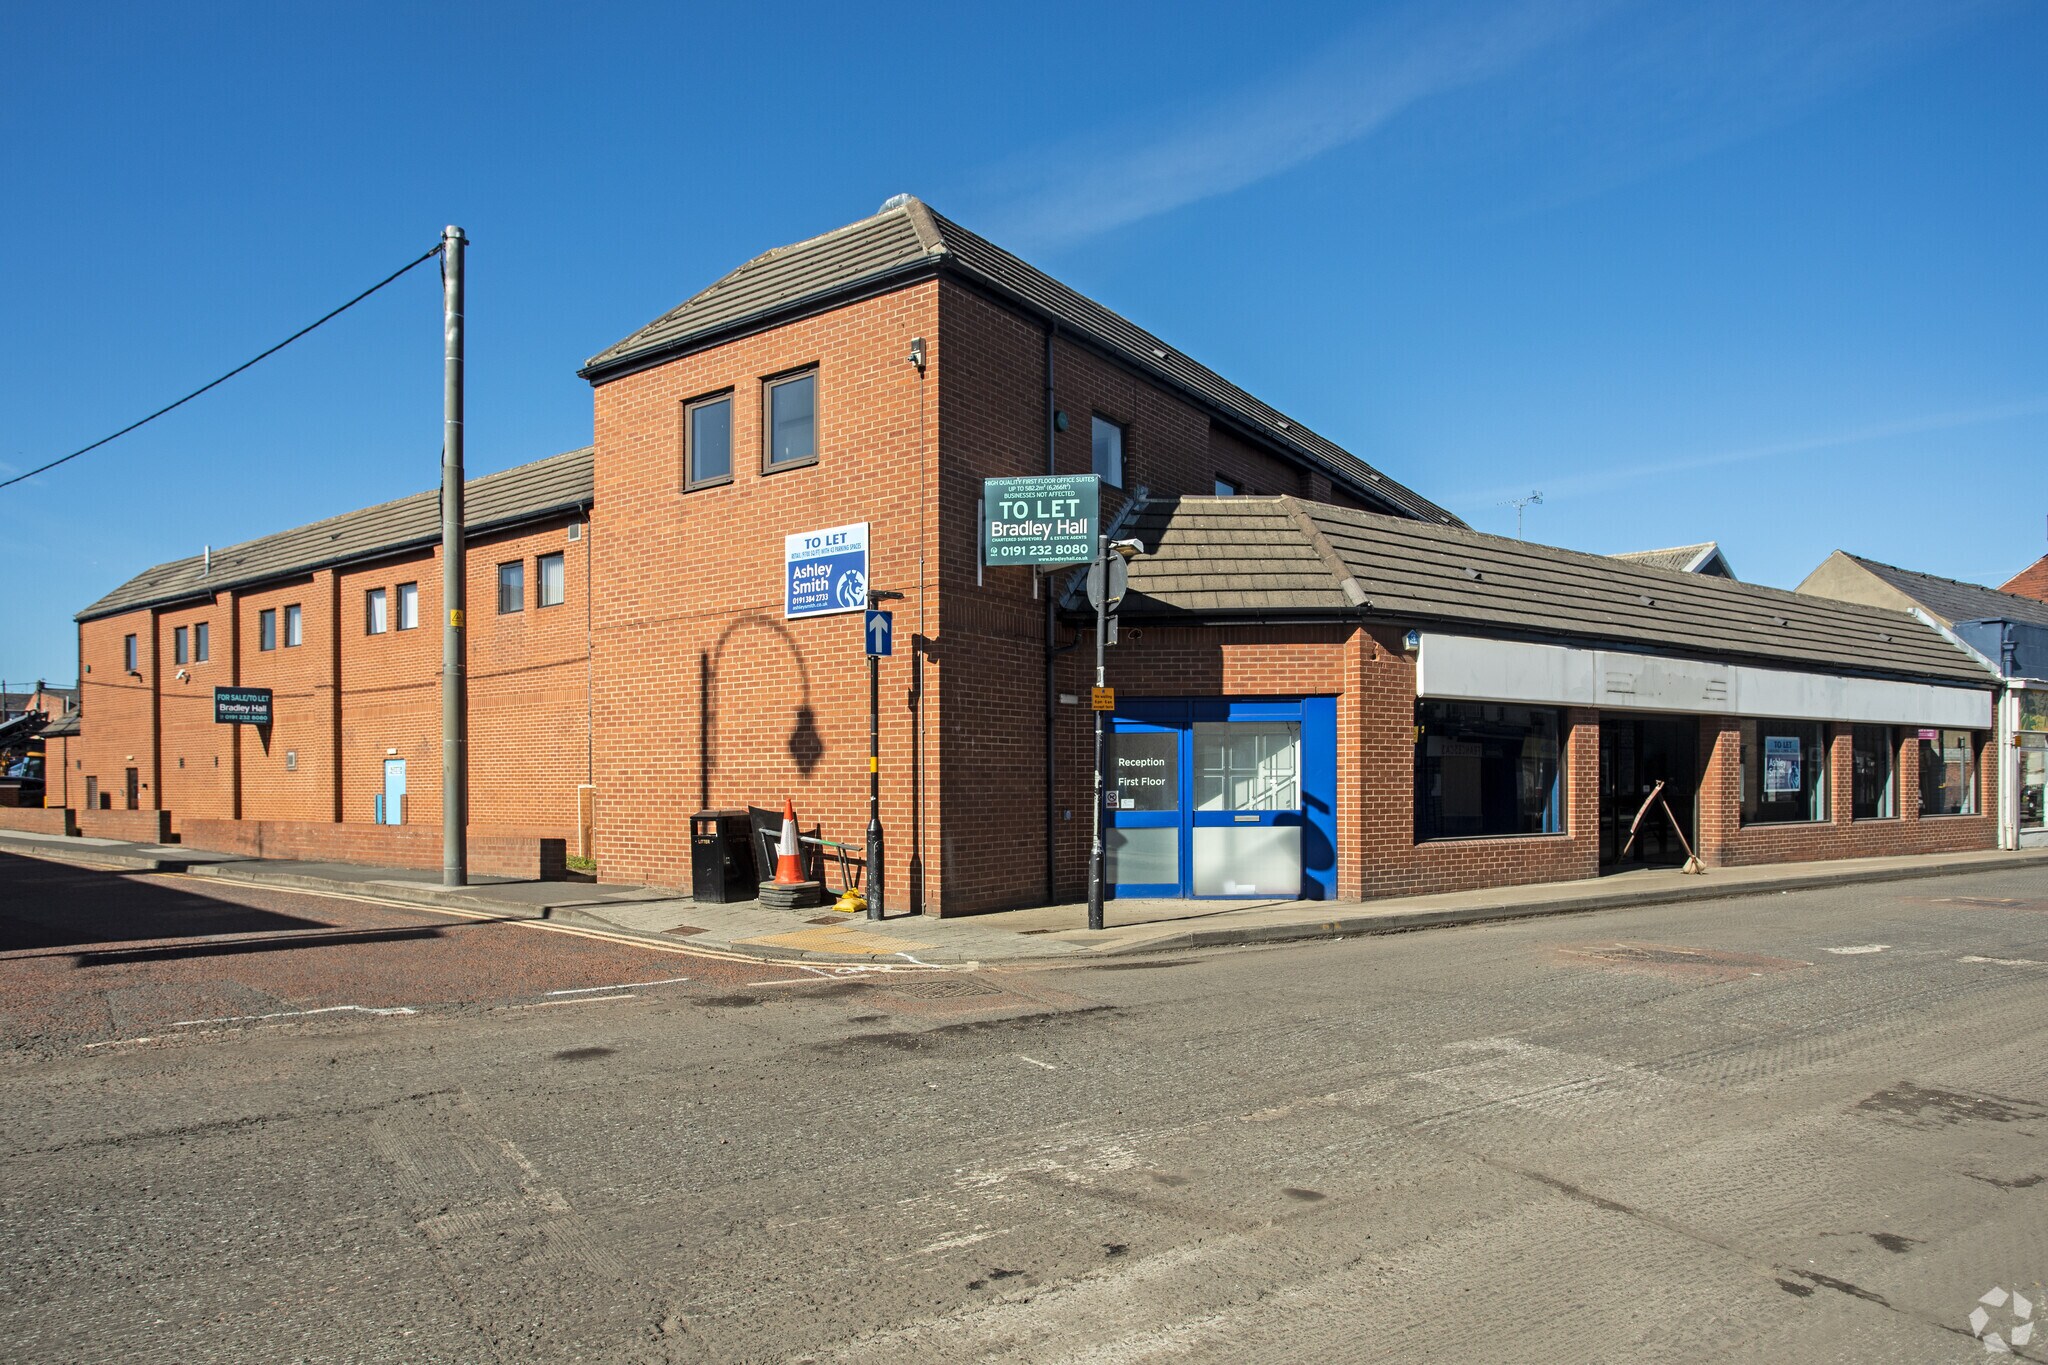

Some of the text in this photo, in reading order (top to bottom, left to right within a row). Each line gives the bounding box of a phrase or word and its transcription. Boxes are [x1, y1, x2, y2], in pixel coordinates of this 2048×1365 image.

[999, 499, 1080, 519] TO LET
[992, 518, 1088, 540] Bradley Hall
[805, 532, 847, 549] TO LET
[1001, 544, 1088, 556] 0191 232 8080
[793, 563, 832, 579] Ashley
[793, 577, 828, 595] Smith
[793, 593, 828, 605] 0191 384 2733
[793, 602, 828, 610] ashleysmith.co.uk
[220, 704, 250, 714] Bradley
[1119, 758, 1165, 767] Reception
[1769, 758, 1786, 769] Ashley
[1119, 777, 1166, 786] First Floor
